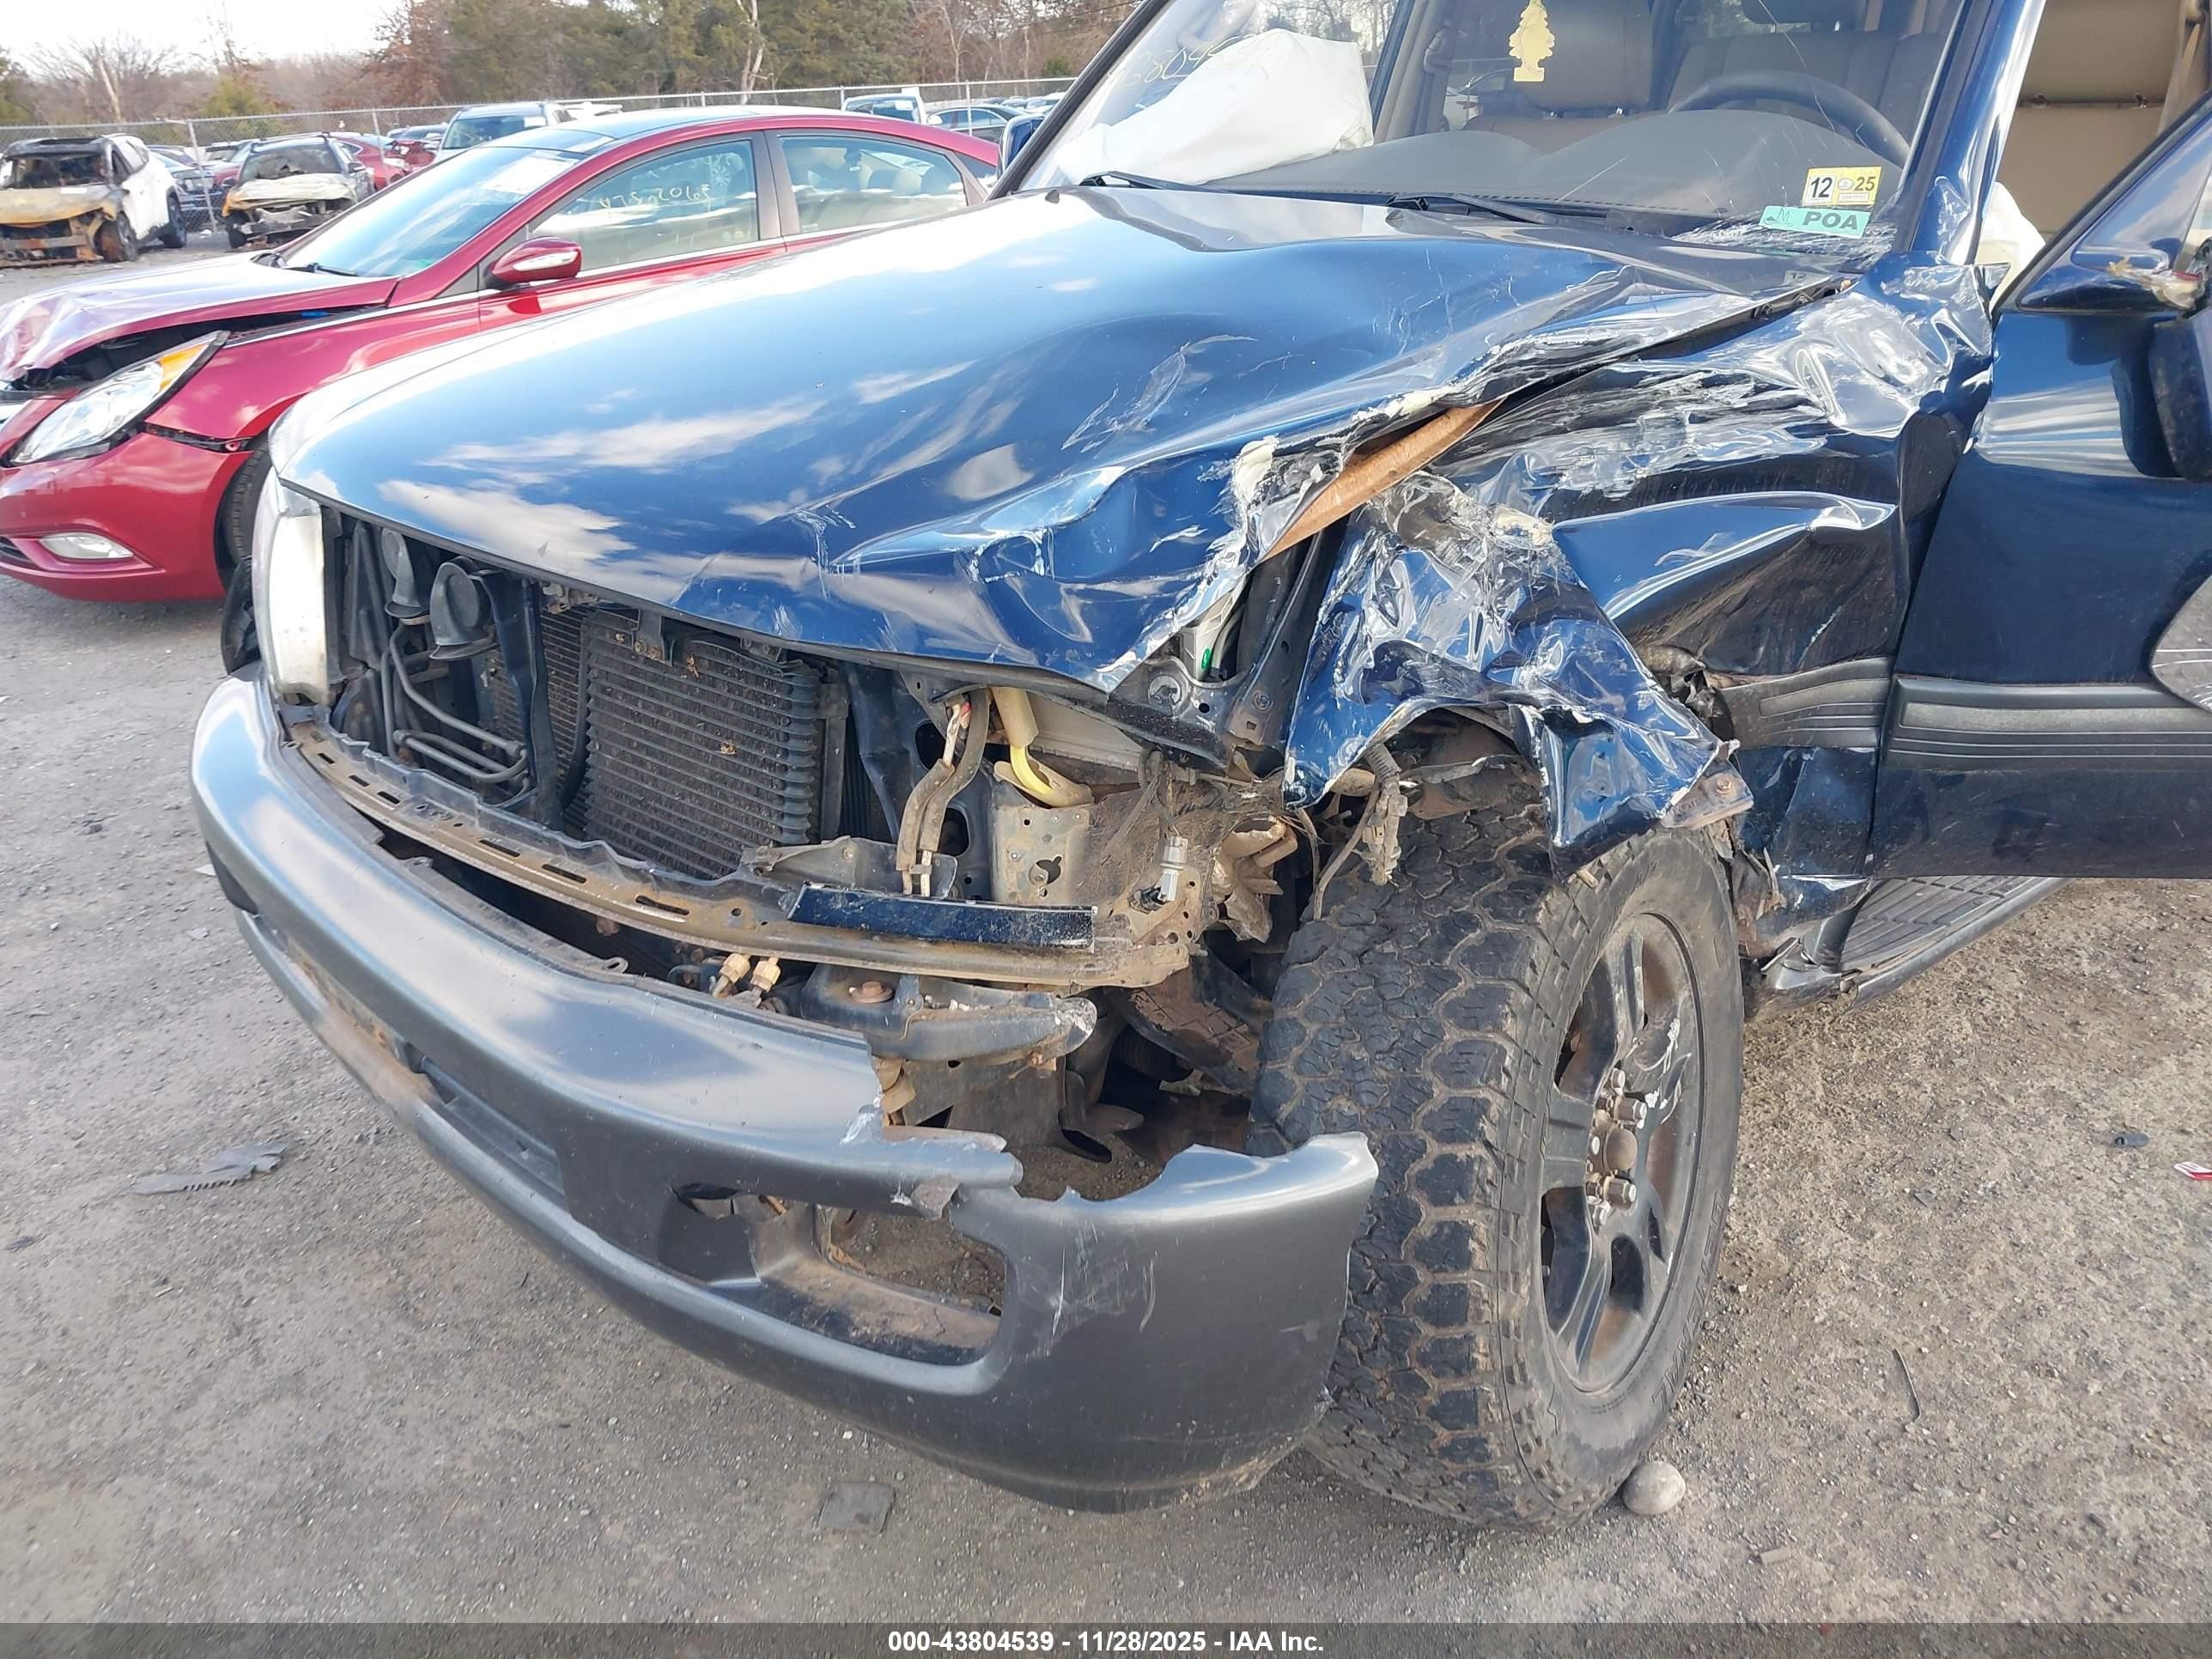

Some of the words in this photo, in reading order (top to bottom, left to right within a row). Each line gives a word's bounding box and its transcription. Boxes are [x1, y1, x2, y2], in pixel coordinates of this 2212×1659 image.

[1810, 177, 1832, 198] 12
[1854, 176, 1875, 191] 25
[1803, 211, 1857, 229] POA
[1651, 1190, 1726, 1413] GENERAL
